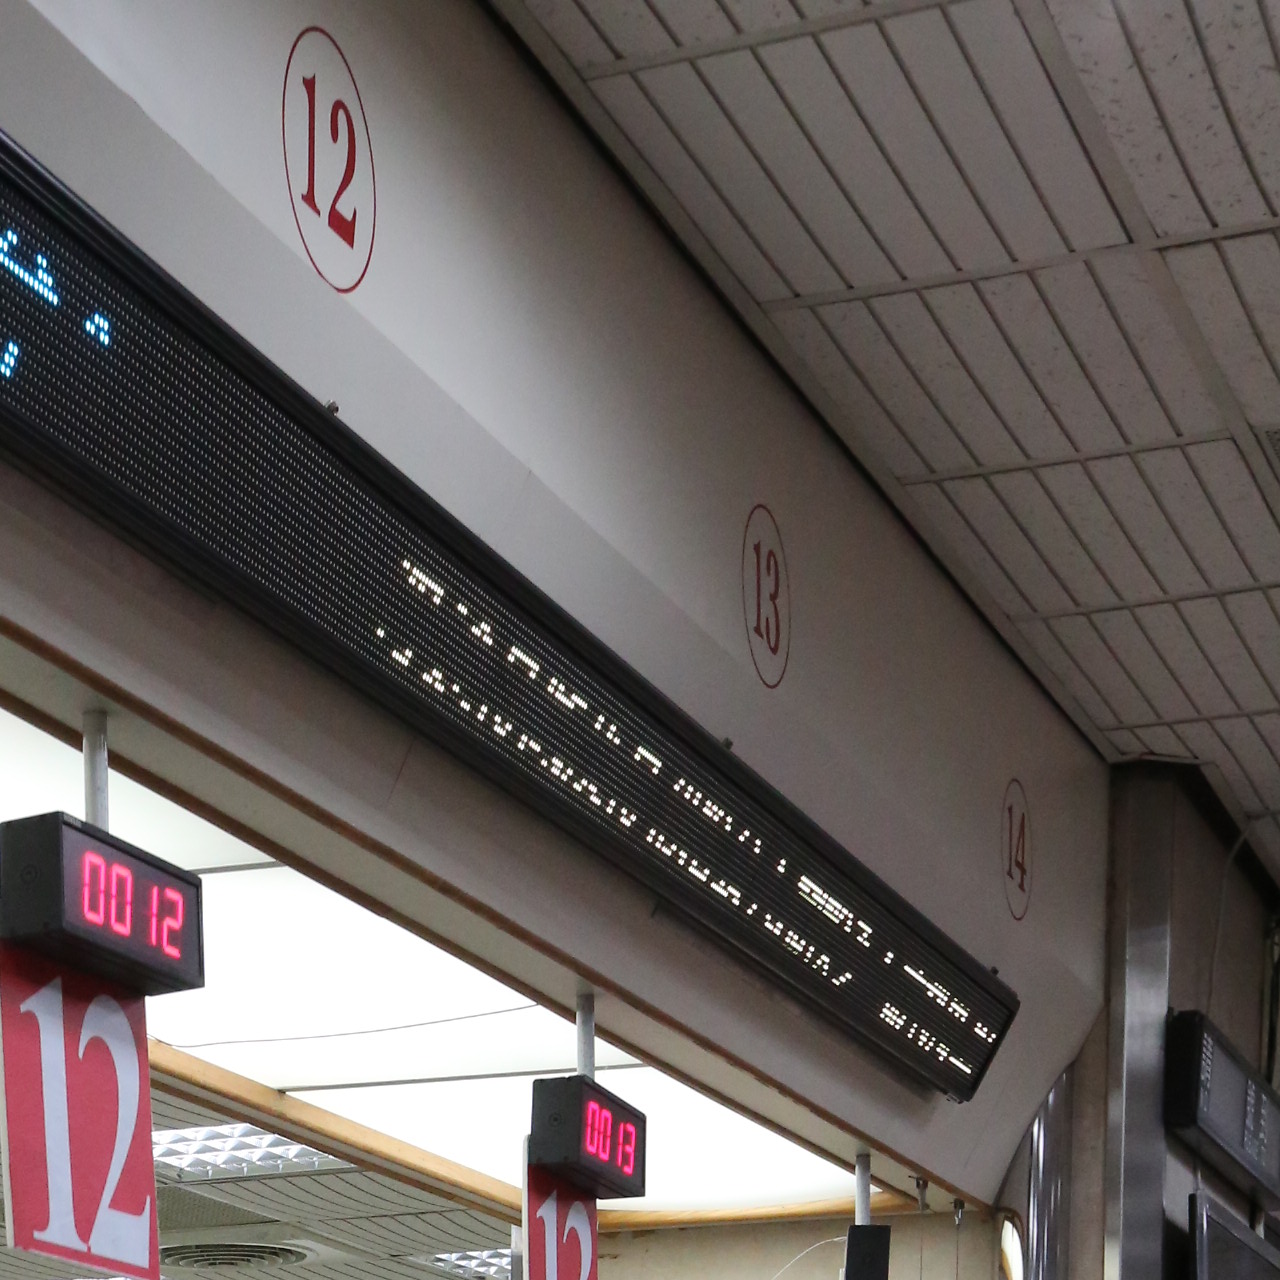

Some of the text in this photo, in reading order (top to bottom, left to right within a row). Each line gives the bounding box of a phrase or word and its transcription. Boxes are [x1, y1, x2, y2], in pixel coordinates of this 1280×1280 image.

[301, 73, 357, 250] 12
[753, 540, 780, 655] 13
[1006, 804, 1027, 893] 14
[81, 851, 184, 959] 0012
[20, 977, 150, 1268] 12
[586, 1100, 636, 1176] 0013
